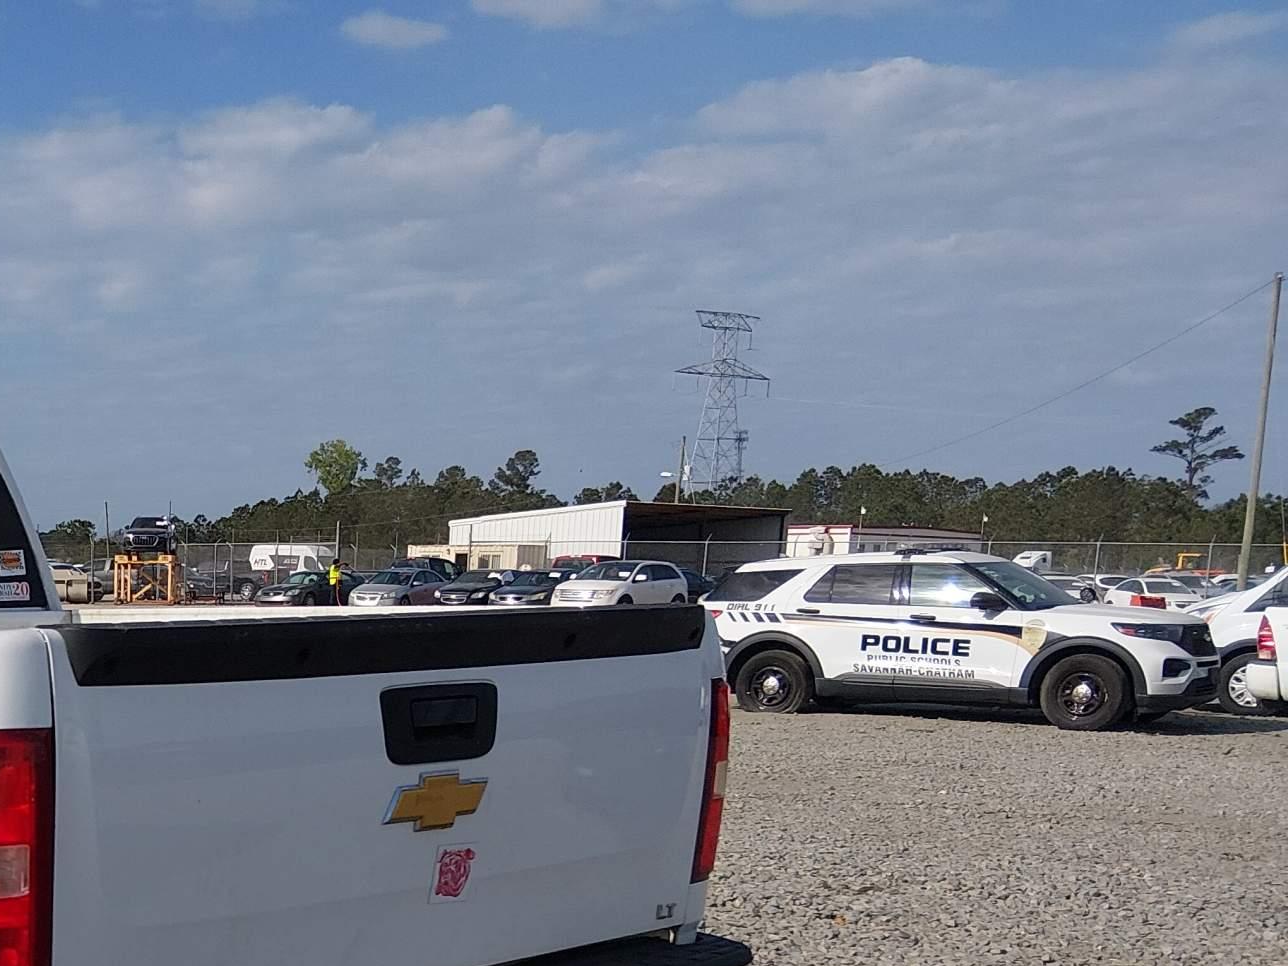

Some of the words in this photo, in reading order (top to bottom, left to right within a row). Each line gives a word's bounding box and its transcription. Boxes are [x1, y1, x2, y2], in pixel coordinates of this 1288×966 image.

[726, 602, 750, 611] DIAL
[754, 603, 776, 612] 911
[860, 634, 972, 657] POLICE
[853, 663, 975, 679] SAVANNAH-CHATHAM
[655, 902, 677, 920] LT
